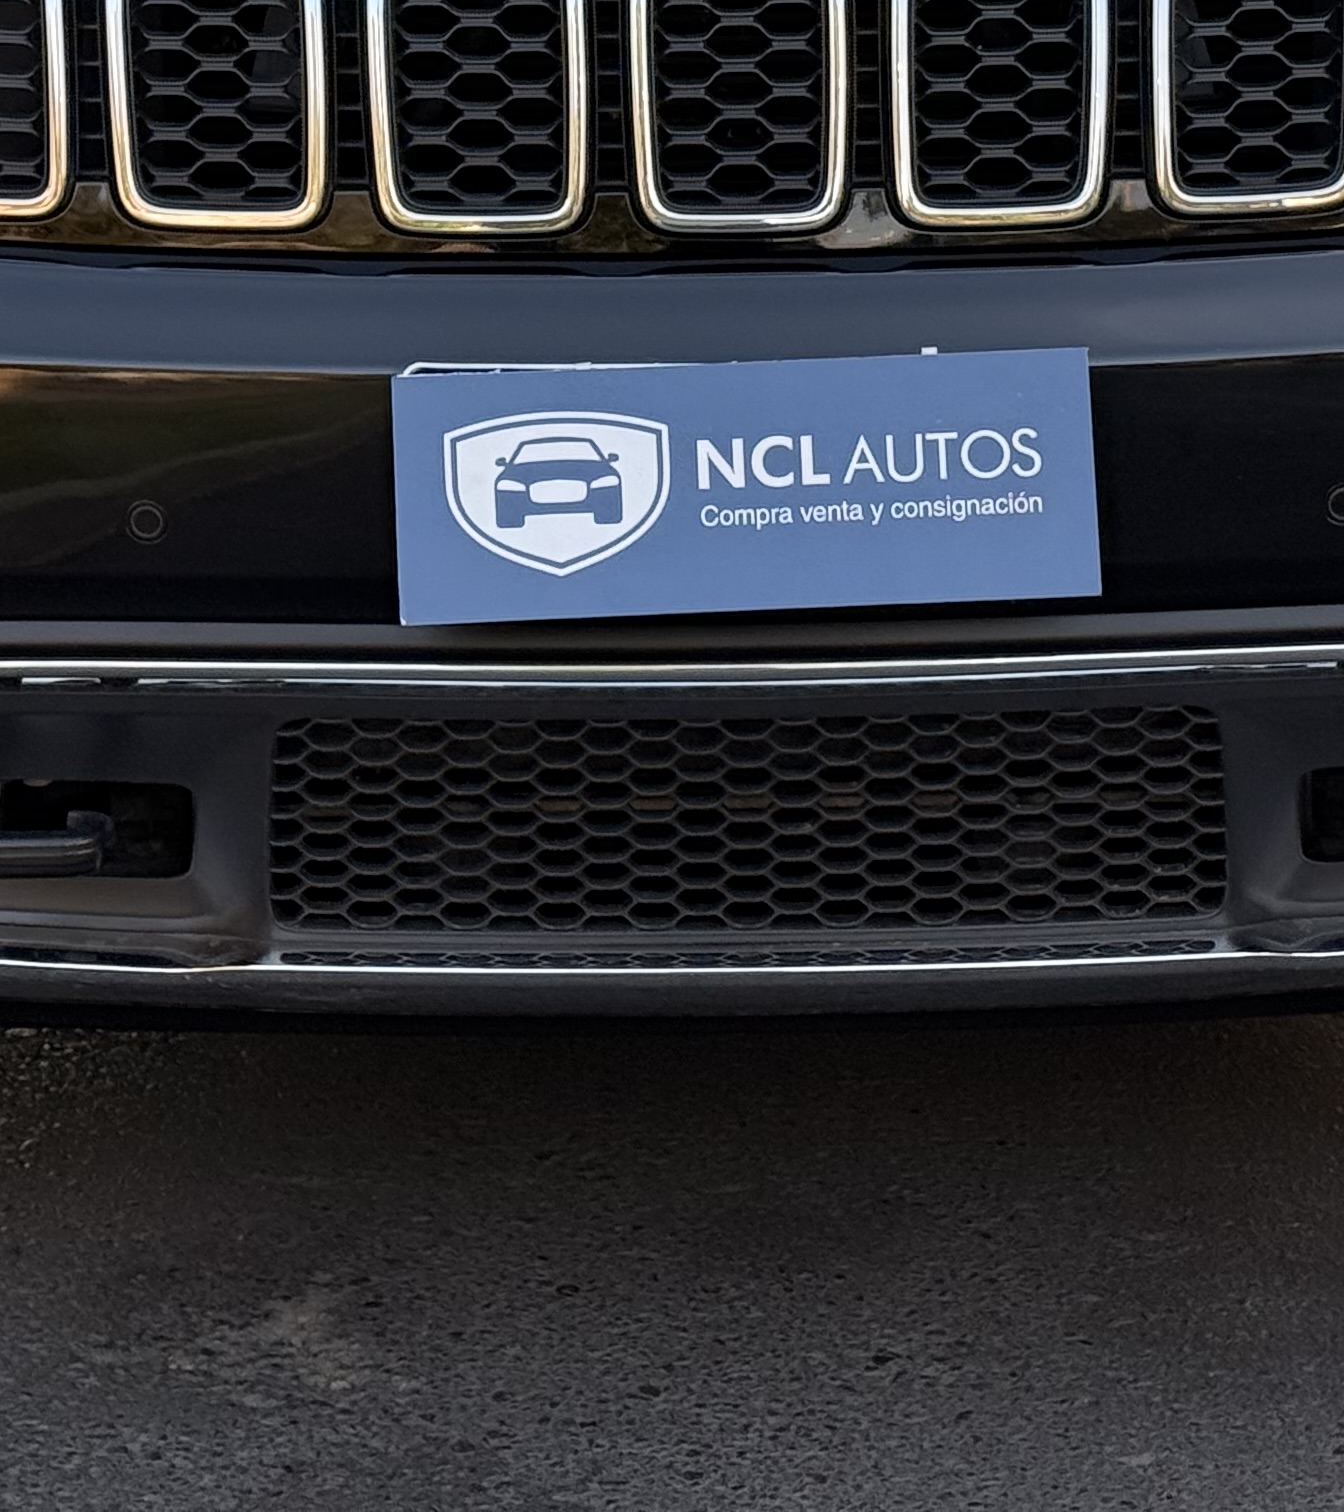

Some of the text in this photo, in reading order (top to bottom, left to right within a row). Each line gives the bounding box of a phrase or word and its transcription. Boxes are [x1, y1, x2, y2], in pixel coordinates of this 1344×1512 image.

[696, 427, 1043, 490] NCL AUTOS
[699, 491, 1044, 531] Compra venta y consignación
